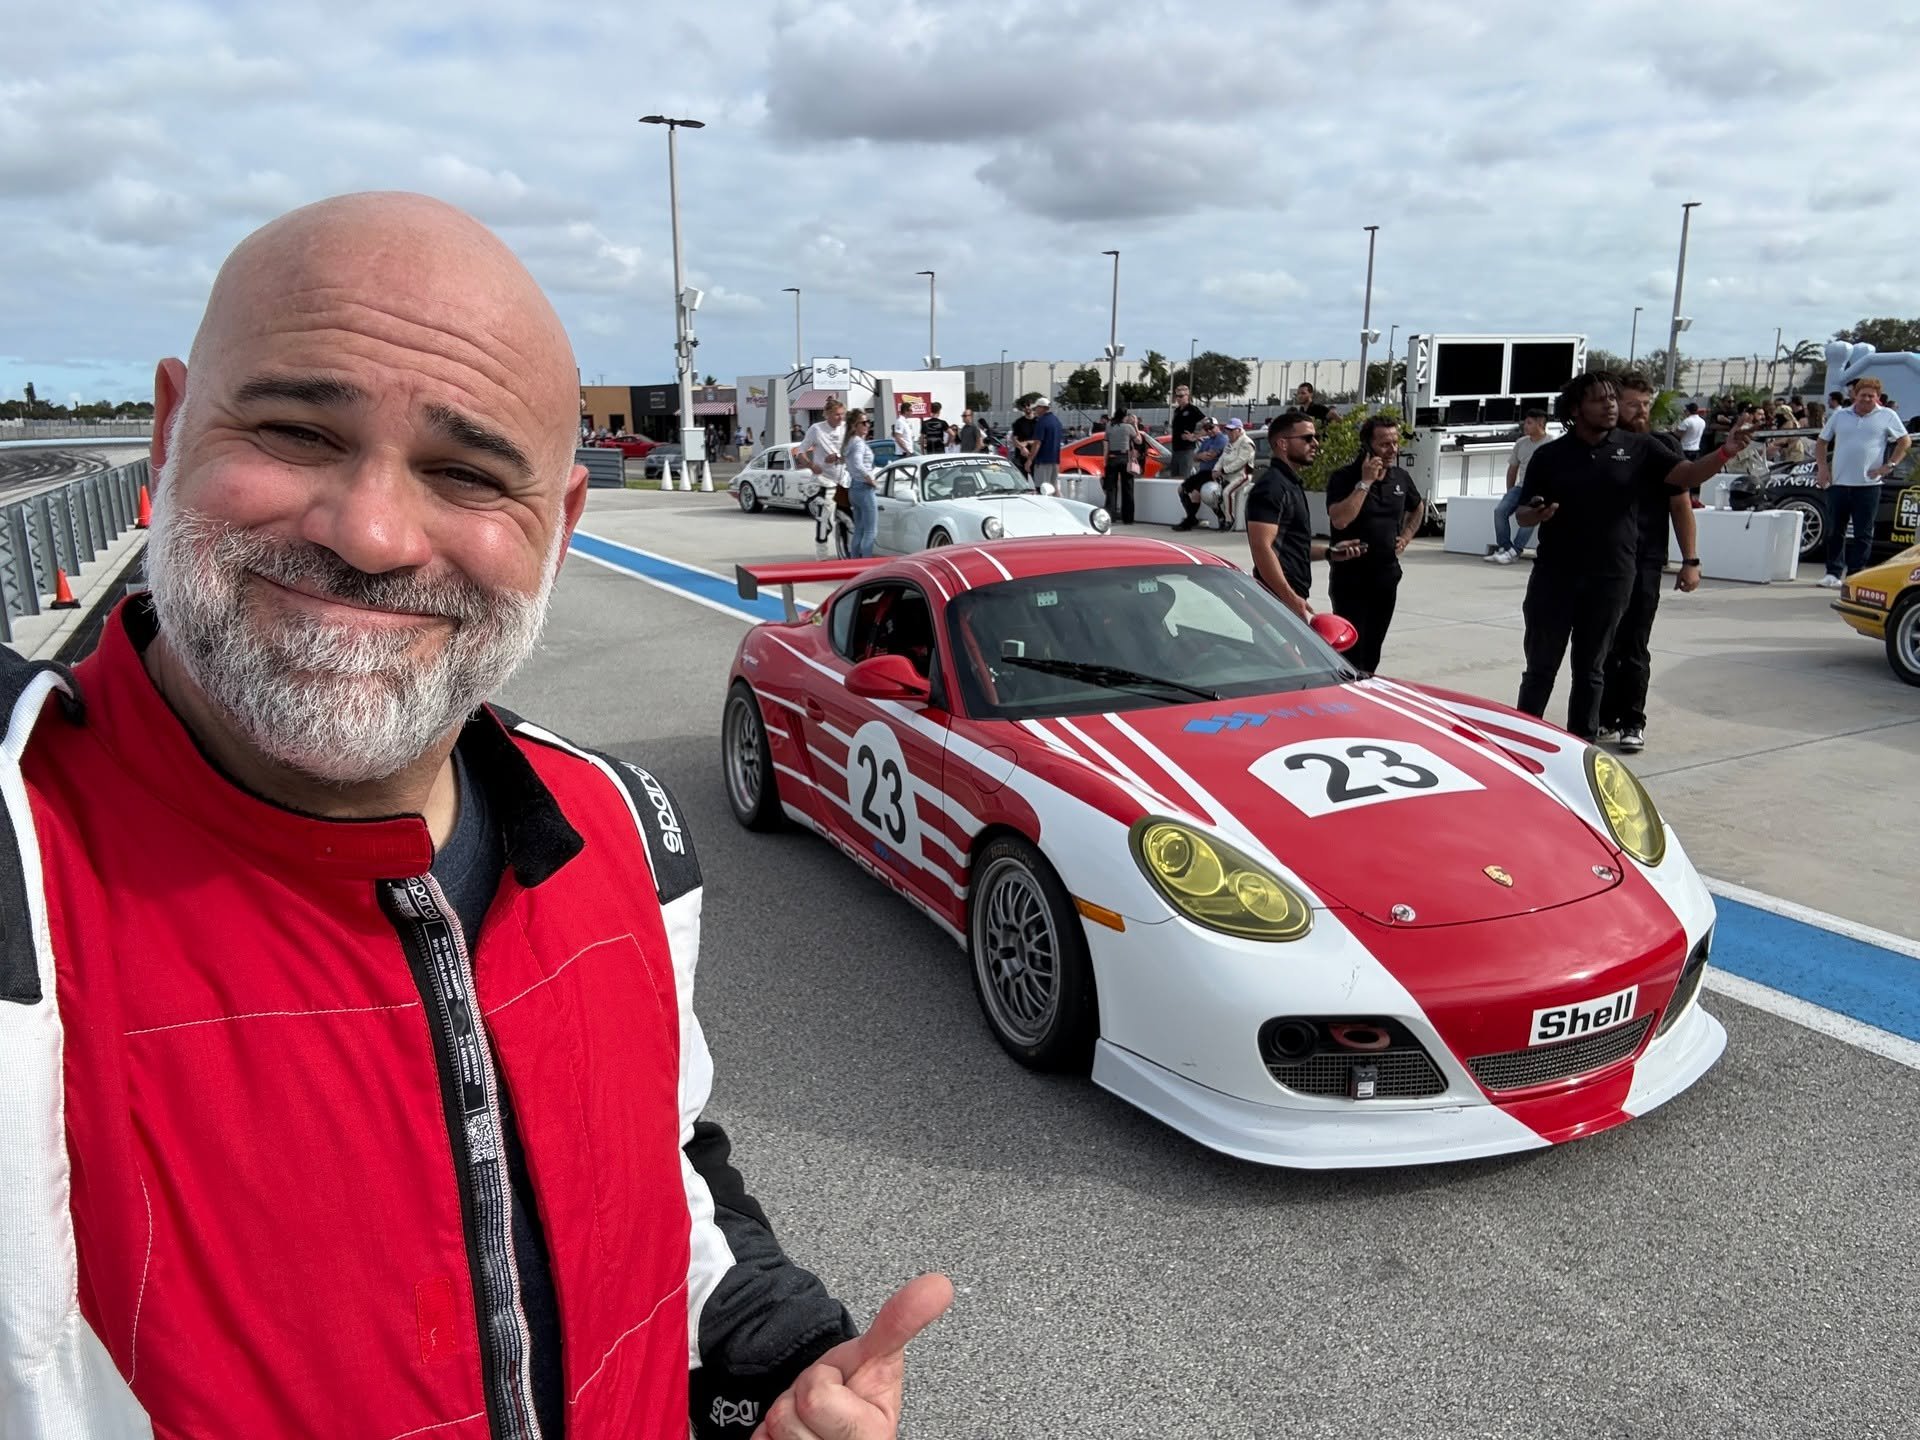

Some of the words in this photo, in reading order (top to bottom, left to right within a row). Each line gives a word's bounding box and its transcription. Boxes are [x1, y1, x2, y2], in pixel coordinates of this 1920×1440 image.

[927, 460, 1012, 471] PORSCHE
[770, 474, 785, 497] 20
[1901, 500, 1920, 512] BA
[1857, 588, 1886, 601] FERODO
[1284, 745, 1440, 803] 23
[857, 744, 907, 844] 23
[406, 877, 440, 919] sparco
[1538, 991, 1633, 1039] Shell
